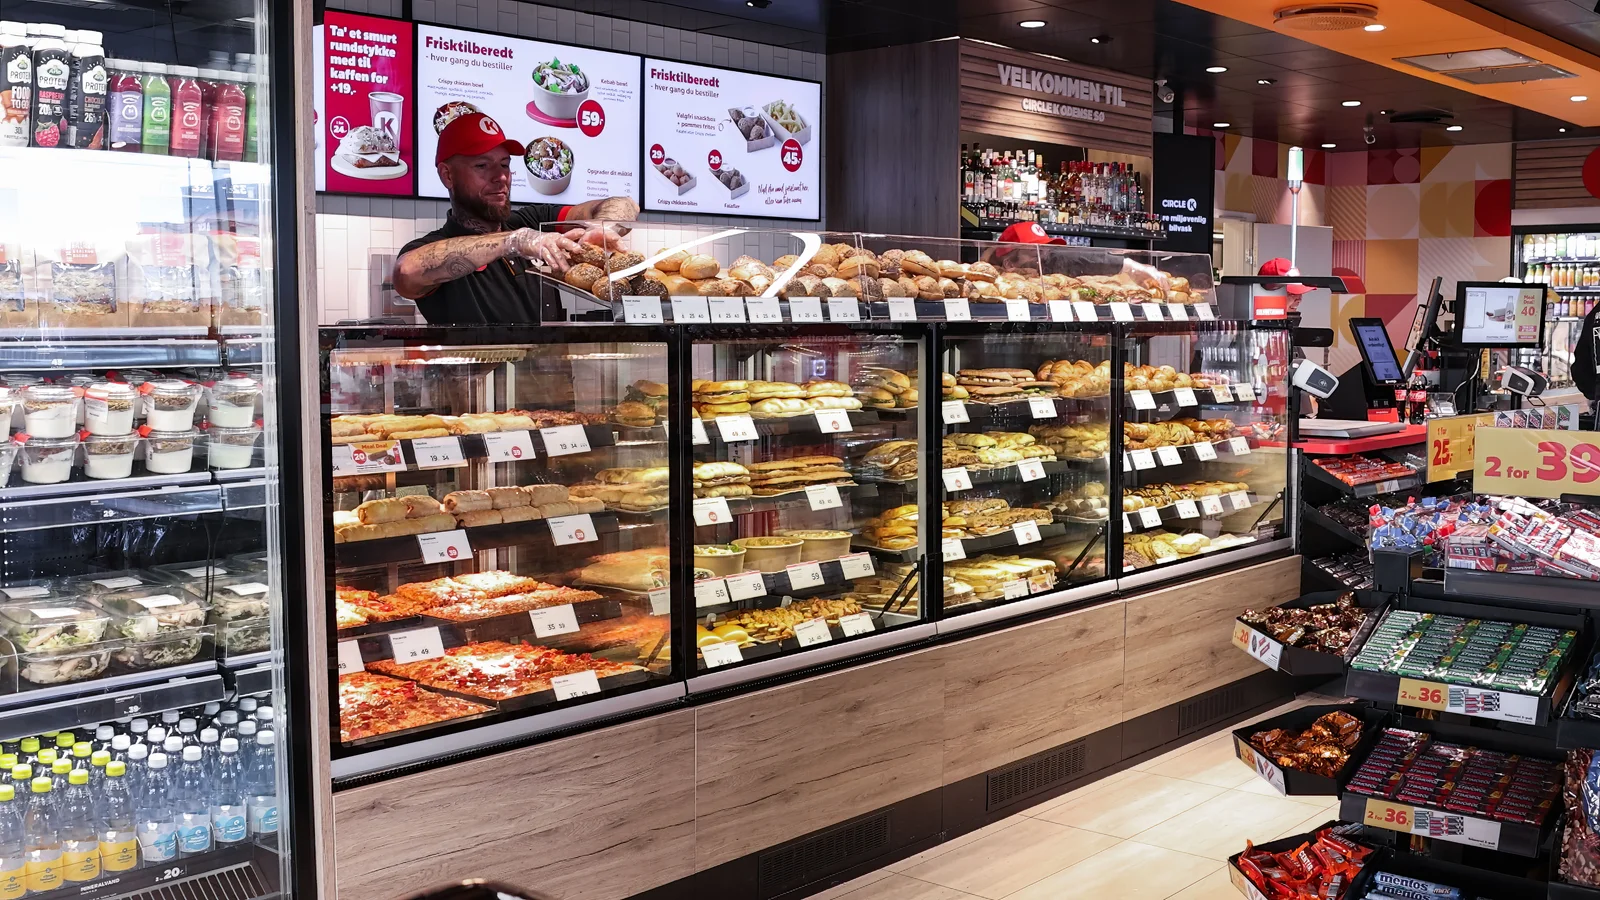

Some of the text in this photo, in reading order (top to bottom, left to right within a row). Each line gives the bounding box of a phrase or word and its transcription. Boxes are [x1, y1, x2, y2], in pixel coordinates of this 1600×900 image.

[349, 30, 362, 39] et
[363, 32, 397, 44] smurt
[330, 42, 396, 57] rundstykke
[426, 36, 513, 59] Frisktilberedt
[330, 56, 371, 68] med til
[430, 53, 448, 62] hver
[450, 57, 469, 67] gang
[471, 59, 480, 67] du
[482, 61, 513, 70] bestiller
[330, 67, 388, 84] kaffen for
[650, 68, 720, 88] Frisktilberedt
[655, 84, 668, 92] hver
[669, 86, 685, 95] gang
[695, 89, 719, 98] bestiller
[997, 64, 1126, 107] VELKOMMEN TIL
[1022, 98, 1105, 122] CIRCLE K ODENSE SØ
[482, 118, 499, 134] K
[1162, 199, 1197, 211] CIRCLE K
[1170, 214, 1206, 225] miljøvenlig
[1169, 224, 1192, 232] bilvask
[1484, 456, 1501, 477] 2
[1507, 466, 1529, 479] for
[862, 563, 871, 571] 59
[811, 573, 820, 581] 59
[752, 583, 762, 591] 59
[1448, 799, 1478, 808] STIMOROL
[1367, 811, 1374, 819] 2
[1496, 807, 1527, 816] STIMOROL
[1329, 832, 1356, 848] CENTER
[1298, 850, 1314, 872] CENTER
[80, 878, 120, 891] MINERALVAND
[1379, 874, 1429, 891] mentos
[1383, 886, 1431, 900] mentos
